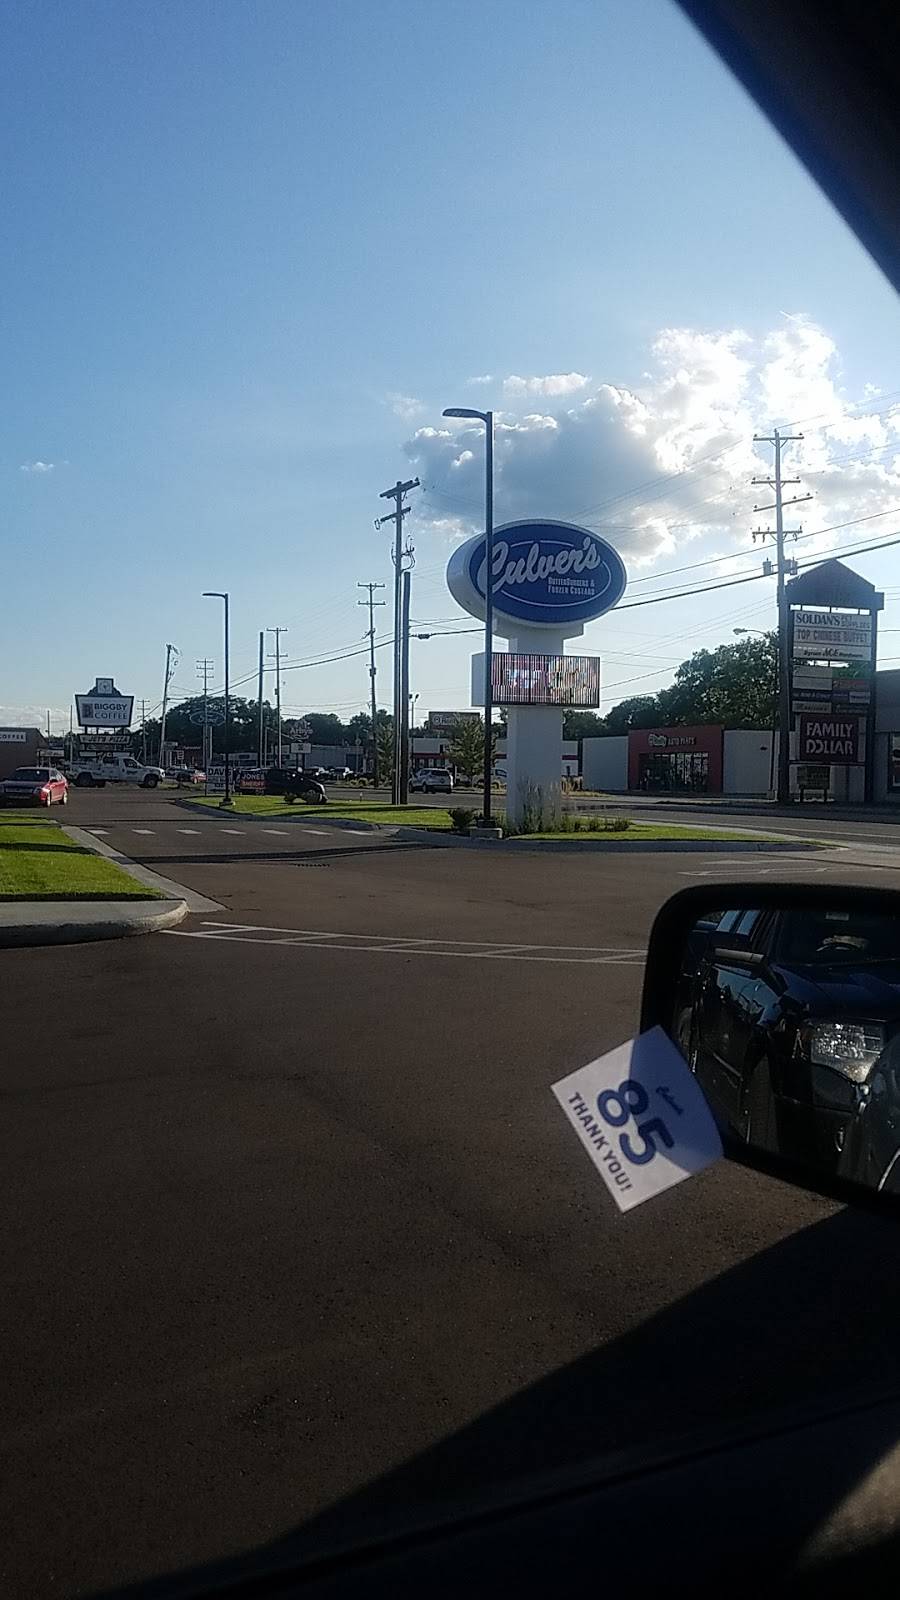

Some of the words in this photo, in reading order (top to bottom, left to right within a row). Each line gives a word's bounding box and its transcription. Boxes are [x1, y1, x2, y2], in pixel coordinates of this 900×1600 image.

[477, 536, 601, 594] Culver's
[796, 613, 840, 626] SOLDAN'S
[797, 629, 811, 640] TOP
[814, 630, 841, 642] CHINESE
[844, 632, 868, 643] BUFFET
[94, 703, 128, 711] BIGGBY
[94, 712, 127, 720] COFFEE
[806, 722, 854, 737] FAMILY
[806, 739, 854, 755] DOLLAR
[597, 1079, 675, 1166] 85
[568, 1091, 610, 1151] THANK
[602, 1149, 635, 1193] YOU!
